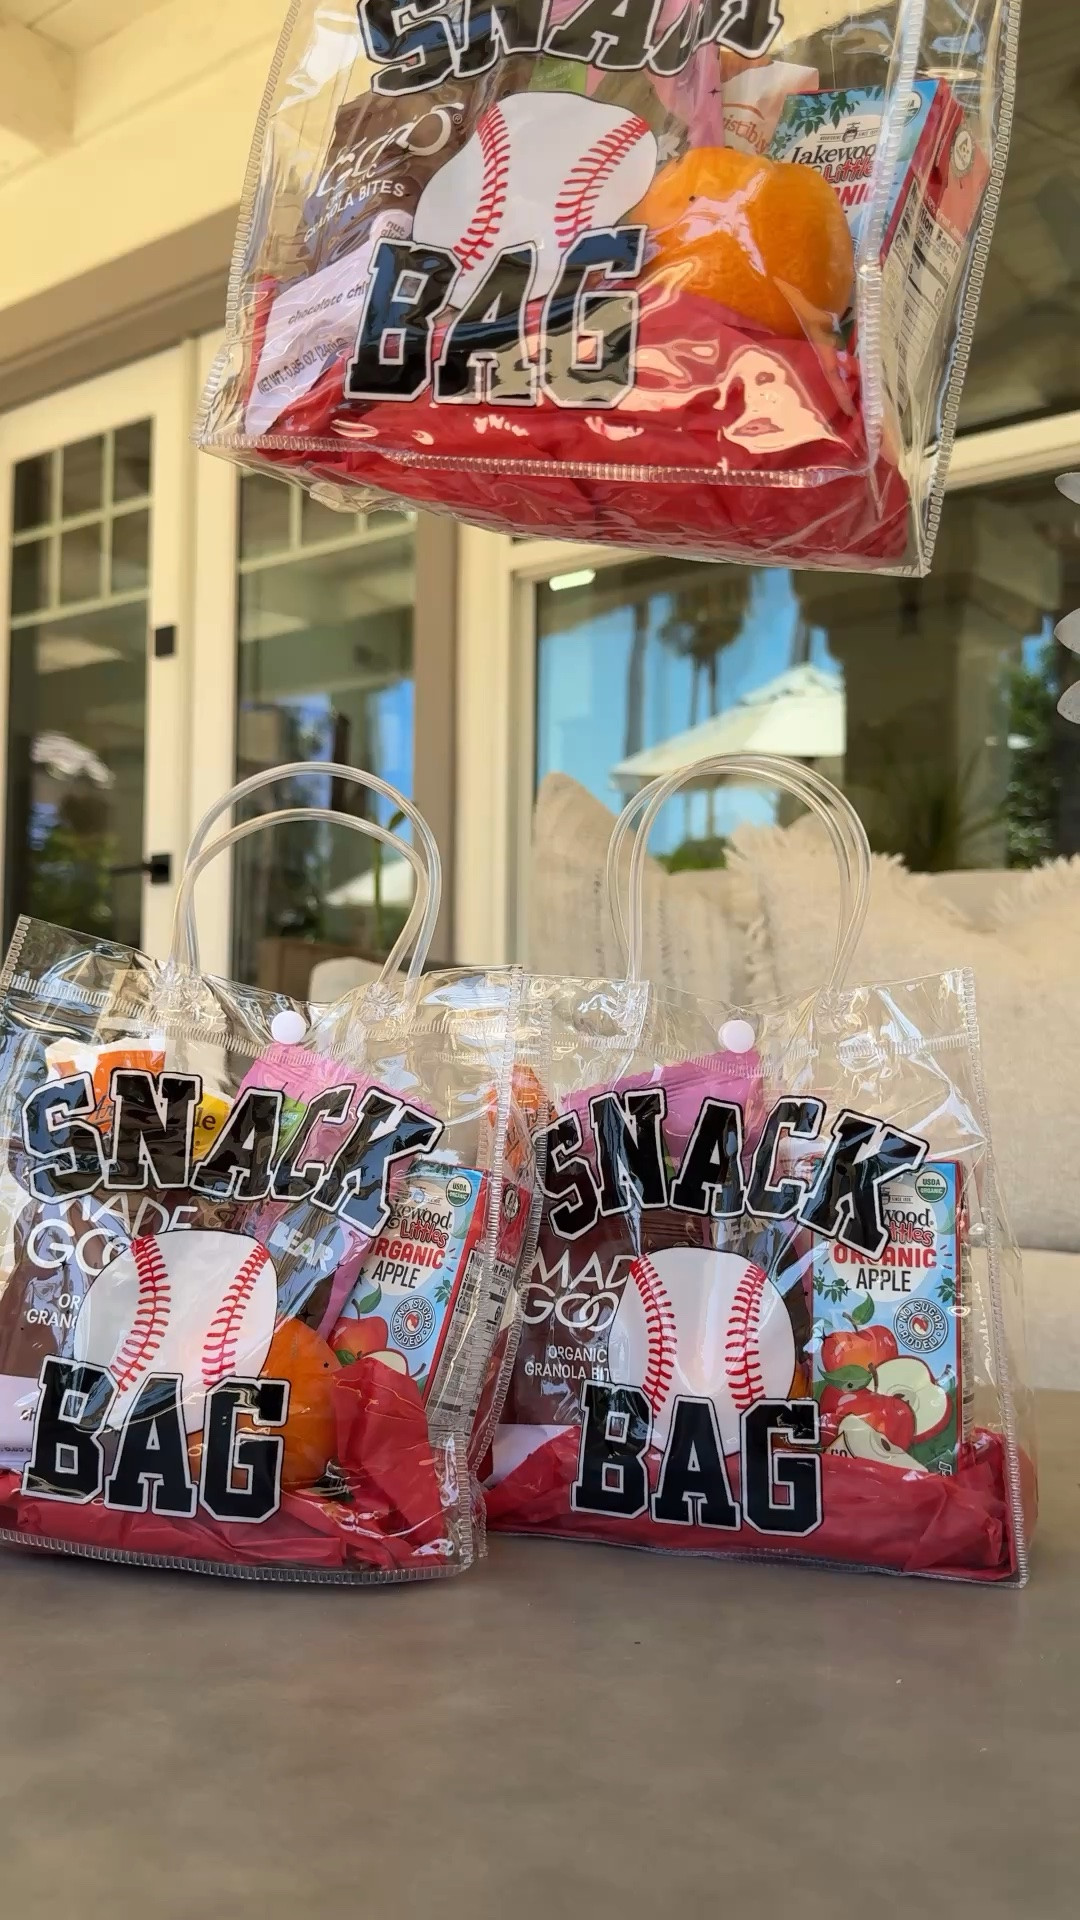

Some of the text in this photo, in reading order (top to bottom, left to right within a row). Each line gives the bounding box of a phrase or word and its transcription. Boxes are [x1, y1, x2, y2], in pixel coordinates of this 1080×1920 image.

[791, 143, 877, 166] Lakewoo
[823, 155, 875, 184] Little
[358, 179, 406, 198] BITES
[287, 292, 344, 325] chocolate
[343, 225, 649, 408] BAG
[23, 1067, 444, 1238] SNACK
[452, 1181, 467, 1192] USDA
[541, 1086, 931, 1260] SNACK
[922, 1178, 941, 1187] USDA
[391, 1203, 453, 1228] kewood
[884, 1208, 931, 1228] wood
[400, 1218, 449, 1249] Littles
[888, 1220, 935, 1247] ttles
[530, 1246, 641, 1290] MAD
[833, 1245, 937, 1268] ORANIC
[371, 1260, 421, 1289] APPLE
[855, 1268, 912, 1293] APPLE
[26, 1308, 77, 1330] GRAN
[397, 1299, 432, 1333] NO SUGAR
[520, 1282, 620, 1332] GOO
[898, 1301, 945, 1332] NO SUGAR
[393, 1324, 423, 1347] ADDED
[900, 1328, 938, 1350] ADDED
[549, 1345, 608, 1363] ORGANIC
[524, 1361, 587, 1380] GRANOLA
[22, 1354, 290, 1523] BAG
[571, 1380, 822, 1536] BAG
